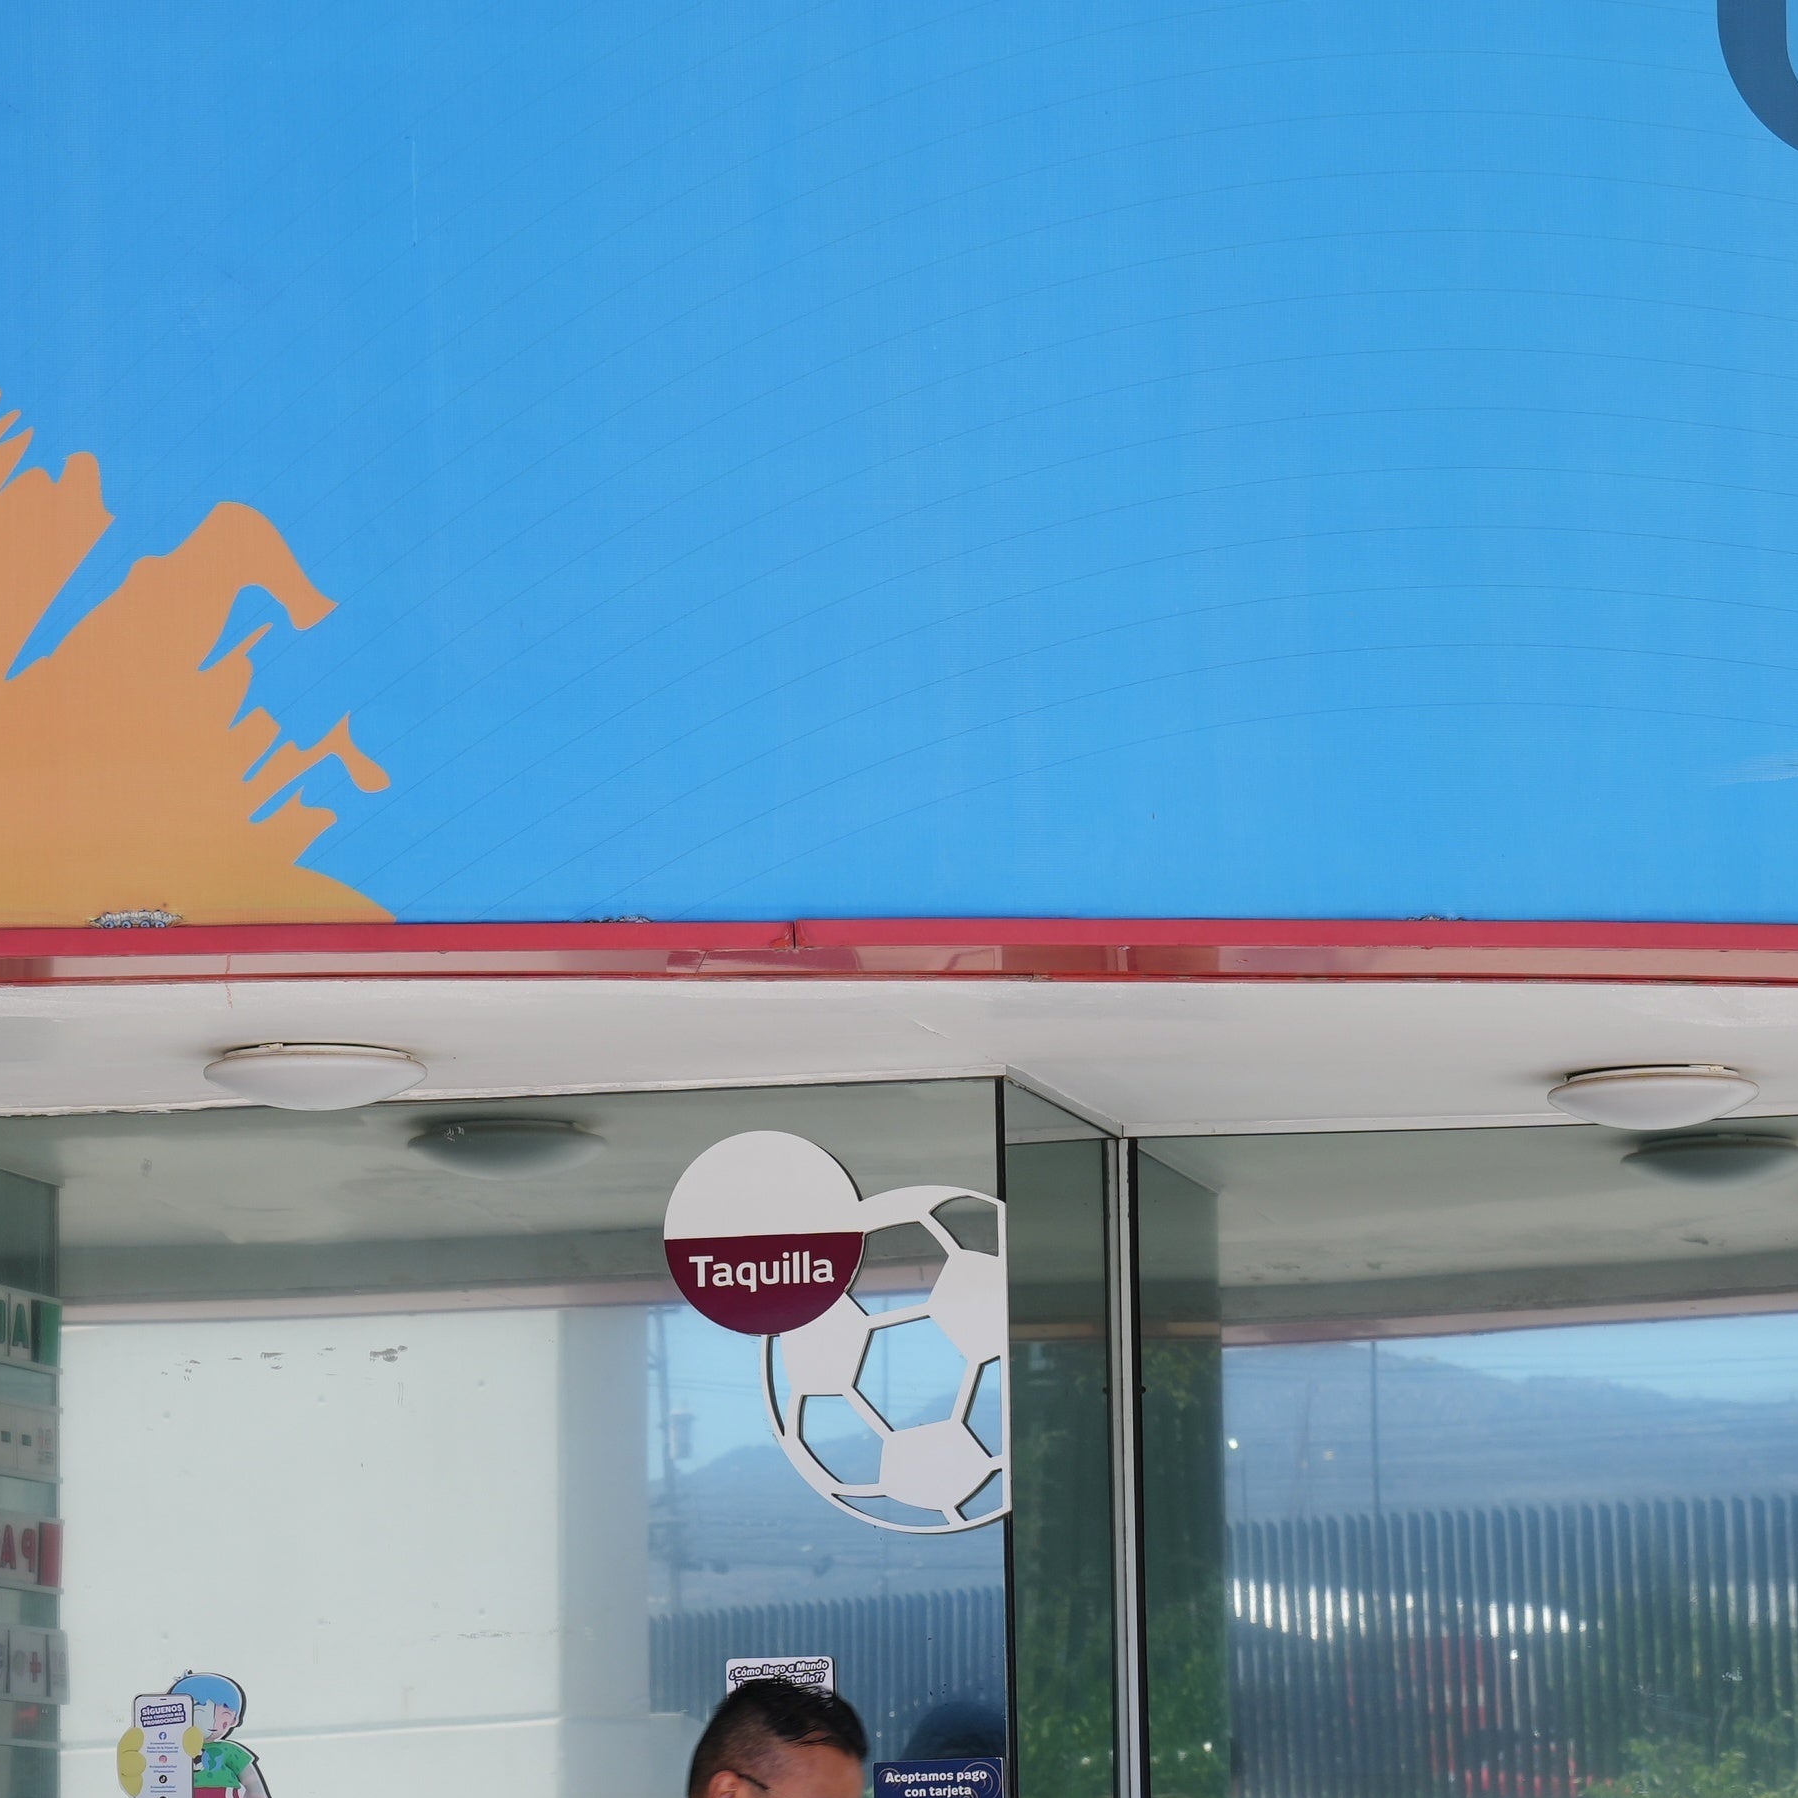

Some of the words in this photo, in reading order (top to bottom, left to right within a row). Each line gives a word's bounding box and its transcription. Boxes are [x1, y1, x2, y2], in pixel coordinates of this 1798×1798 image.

[688, 1251, 835, 1293] Taquilla
[729, 1666, 761, 1680] ¿Cómo
[762, 1664, 786, 1675] llego
[787, 1665, 794, 1673] a
[795, 1659, 829, 1672] Mundo
[885, 1772, 954, 1784] Aceptamos
[956, 1770, 987, 1782] pago
[904, 1788, 926, 1797] con
[929, 1785, 971, 1798] tarjeta
